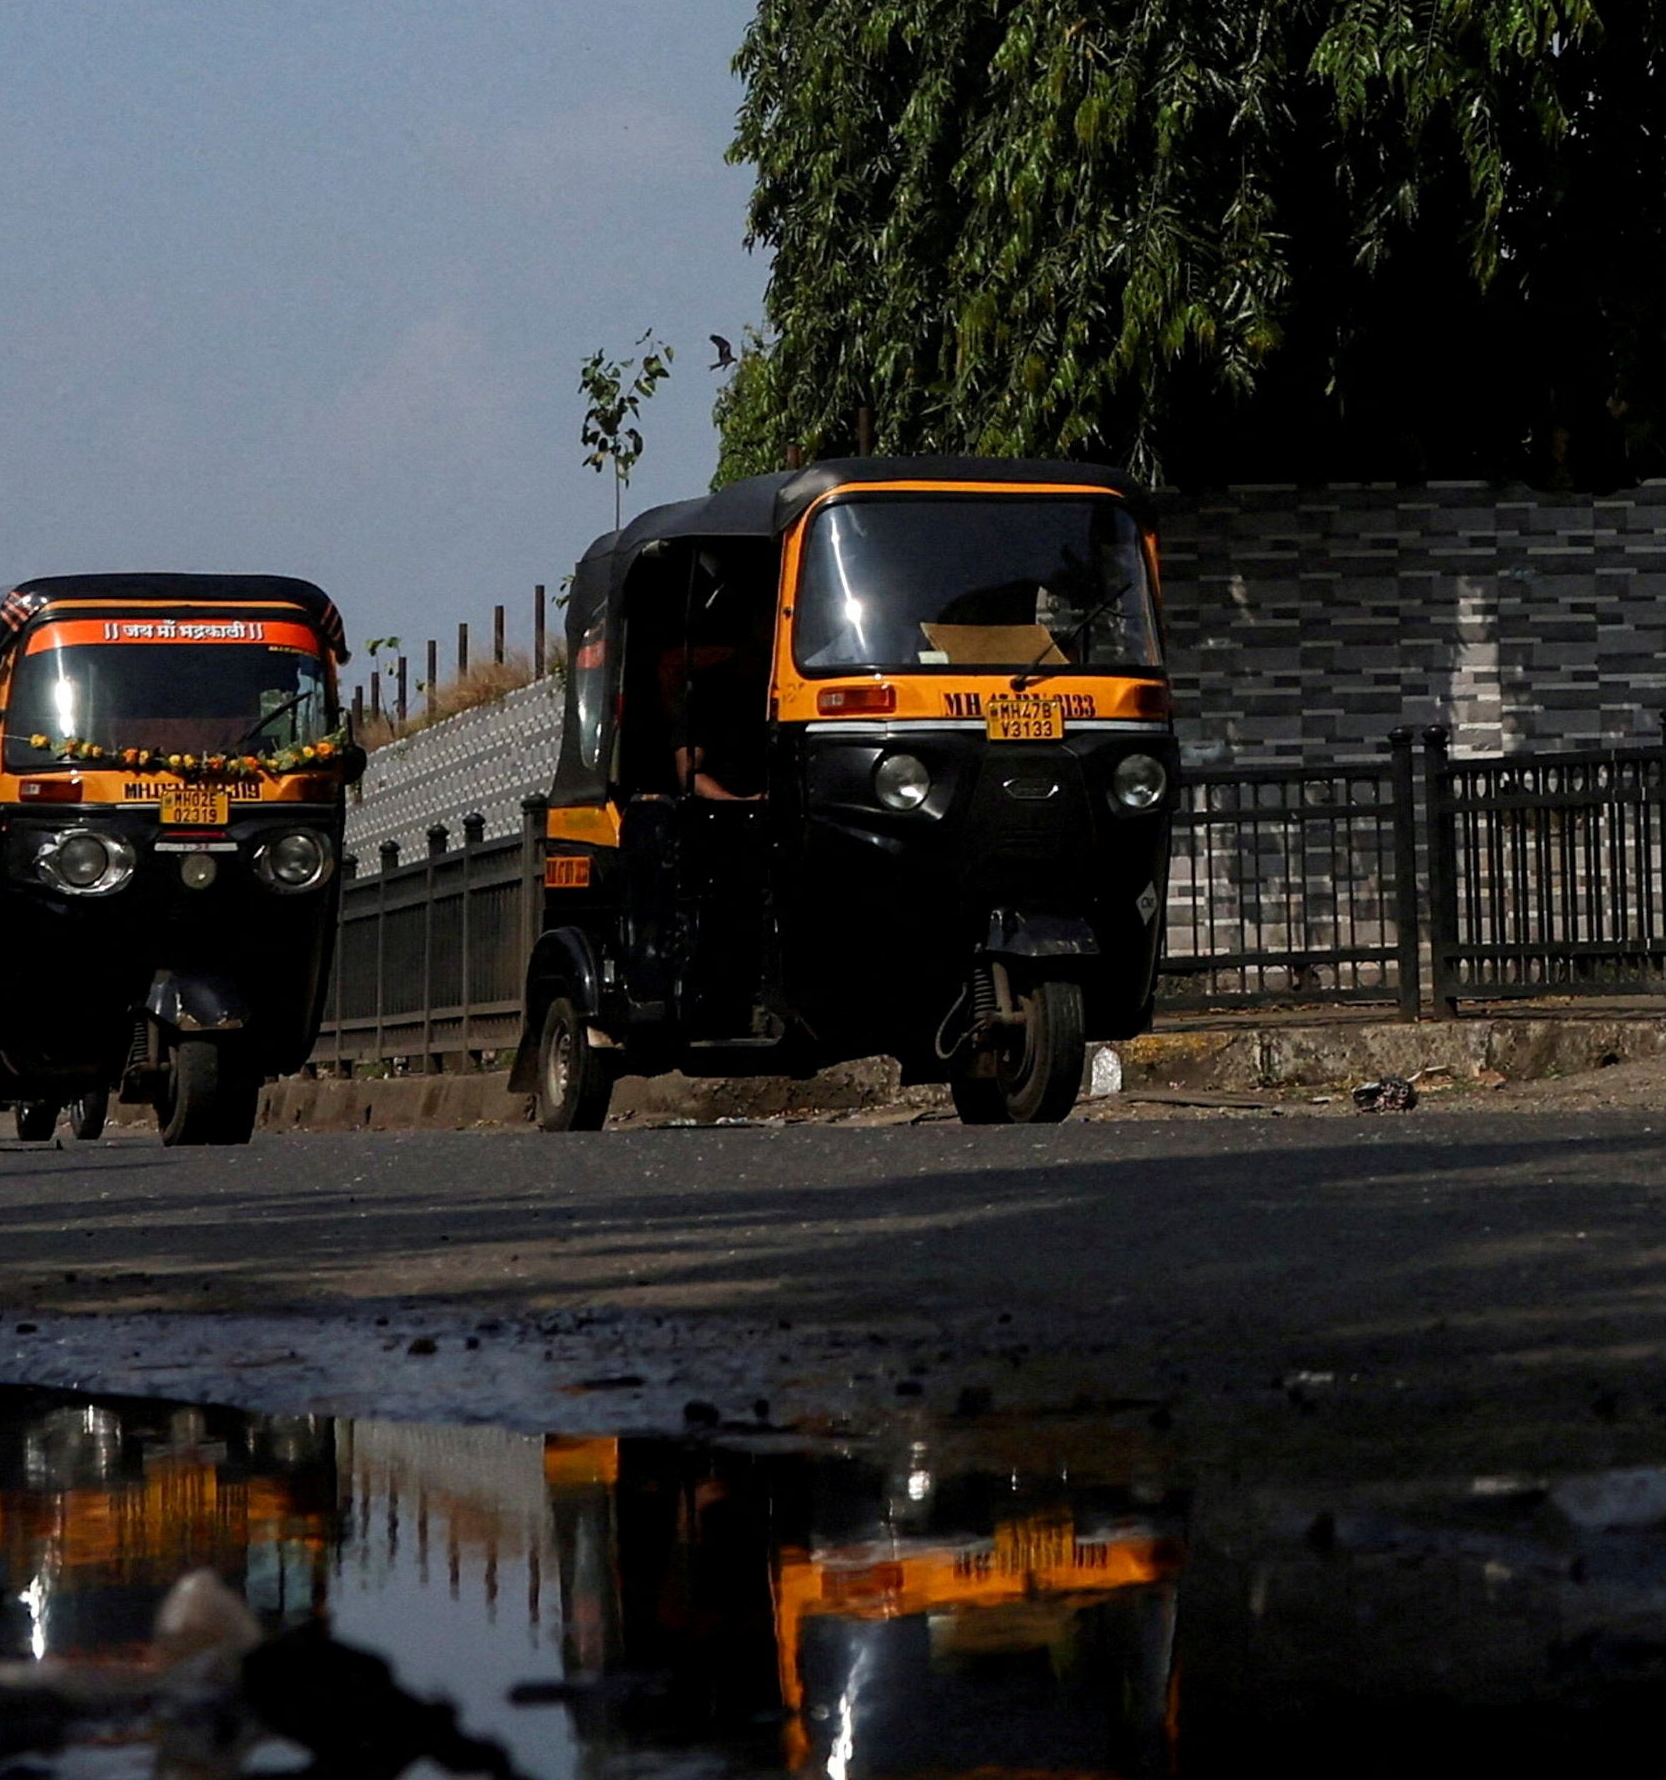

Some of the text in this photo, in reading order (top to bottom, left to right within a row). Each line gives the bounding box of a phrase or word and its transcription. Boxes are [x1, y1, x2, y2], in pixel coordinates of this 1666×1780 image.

[123, 623, 154, 639] जय
[1000, 703, 1052, 719] MH47B
[1001, 721, 1052, 738] V3133
[174, 792, 217, 808] MH02E
